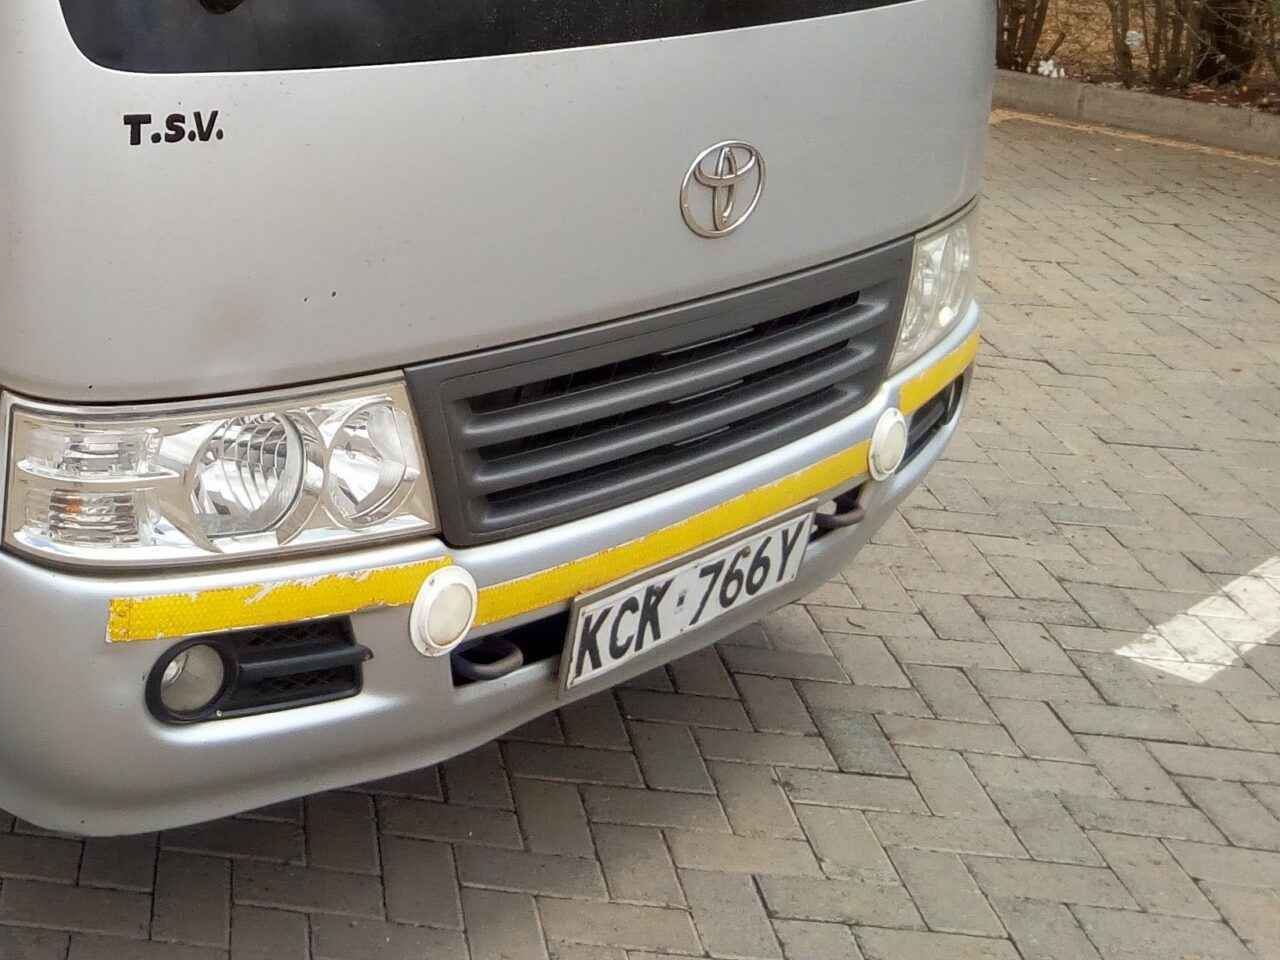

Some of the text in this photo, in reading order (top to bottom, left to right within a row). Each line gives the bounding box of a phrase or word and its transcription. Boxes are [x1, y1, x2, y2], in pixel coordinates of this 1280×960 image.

[123, 110, 224, 146] T.S.V.
[575, 515, 806, 679] KCK 766Y
